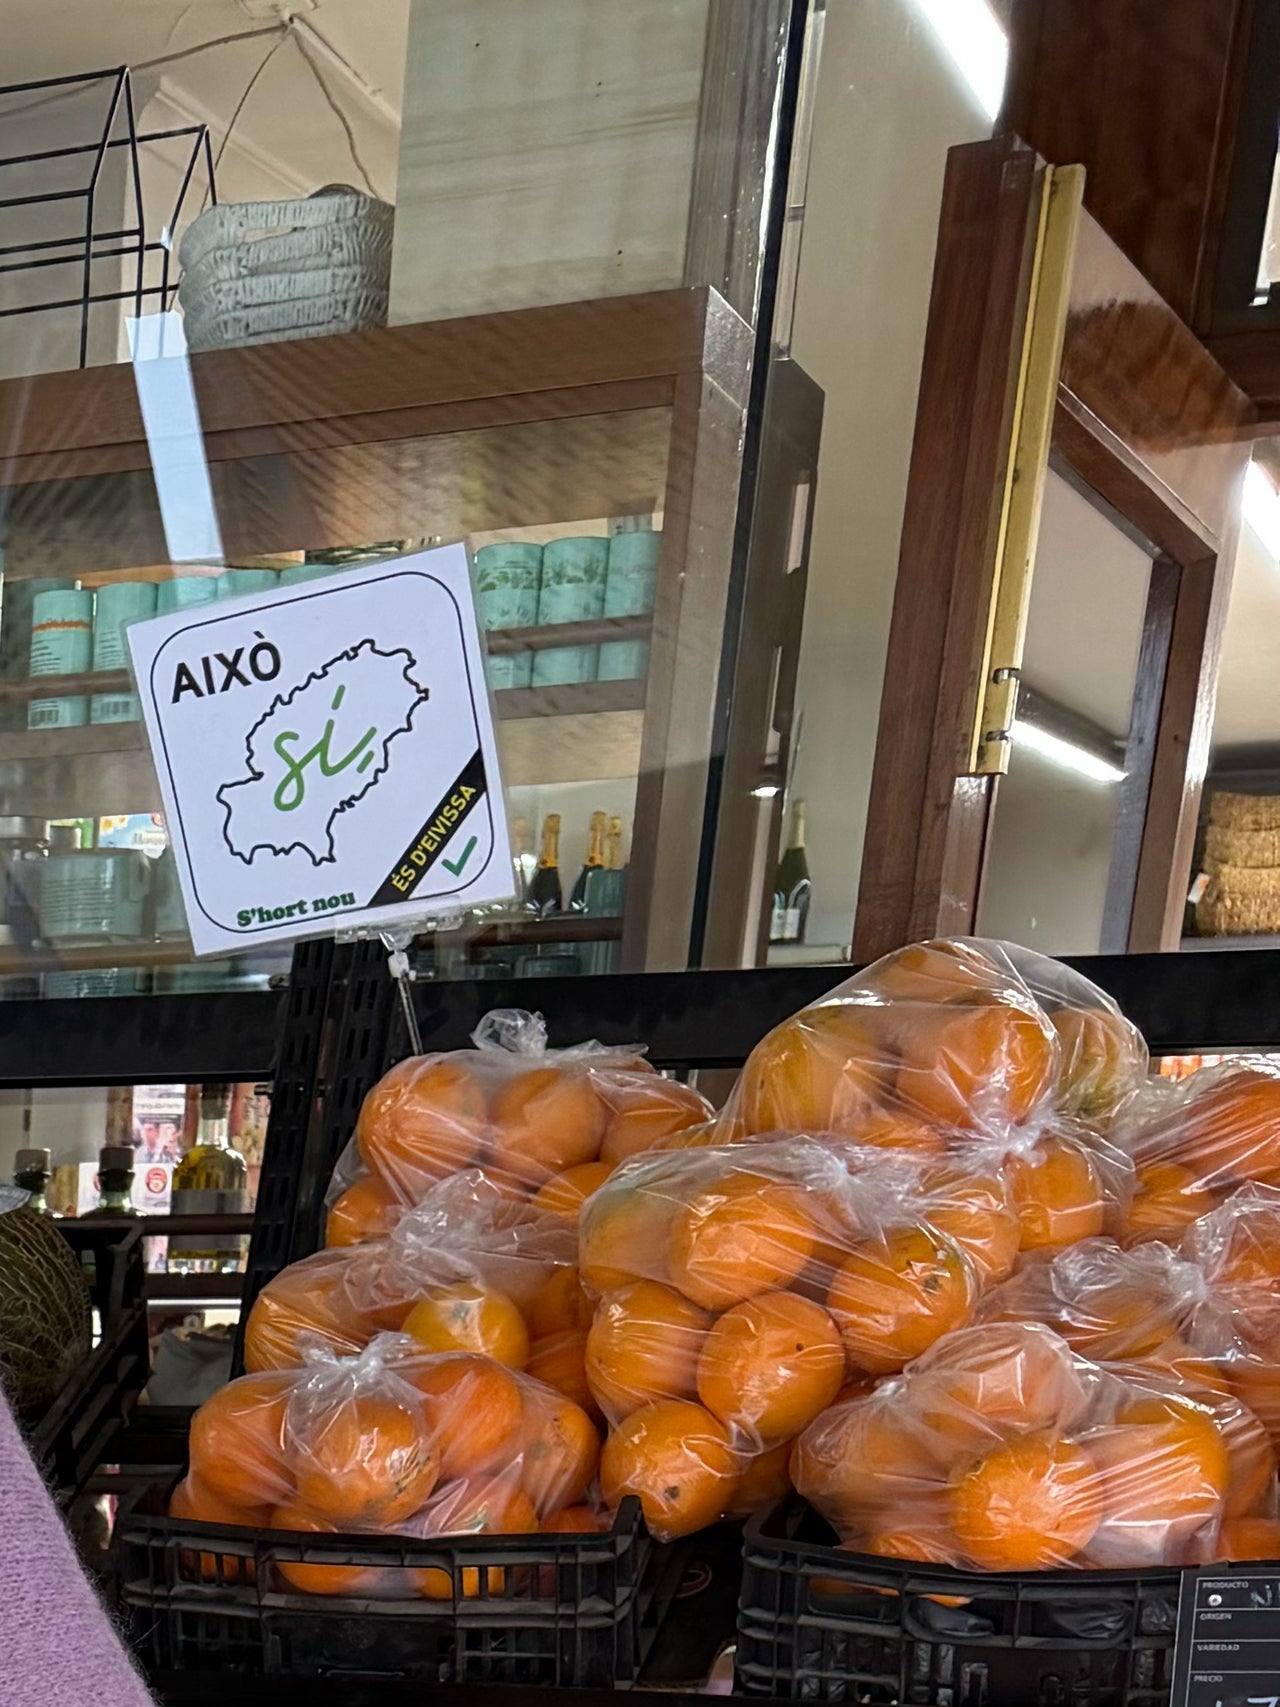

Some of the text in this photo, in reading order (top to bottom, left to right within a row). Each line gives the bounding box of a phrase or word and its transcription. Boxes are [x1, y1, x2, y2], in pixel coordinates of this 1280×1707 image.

[171, 631, 281, 704] AIXÒ
[391, 785, 477, 893] ÉS D'EIVISSA
[237, 892, 356, 927] S'hort nou
[1202, 1581, 1249, 1589] PRODUCTO
